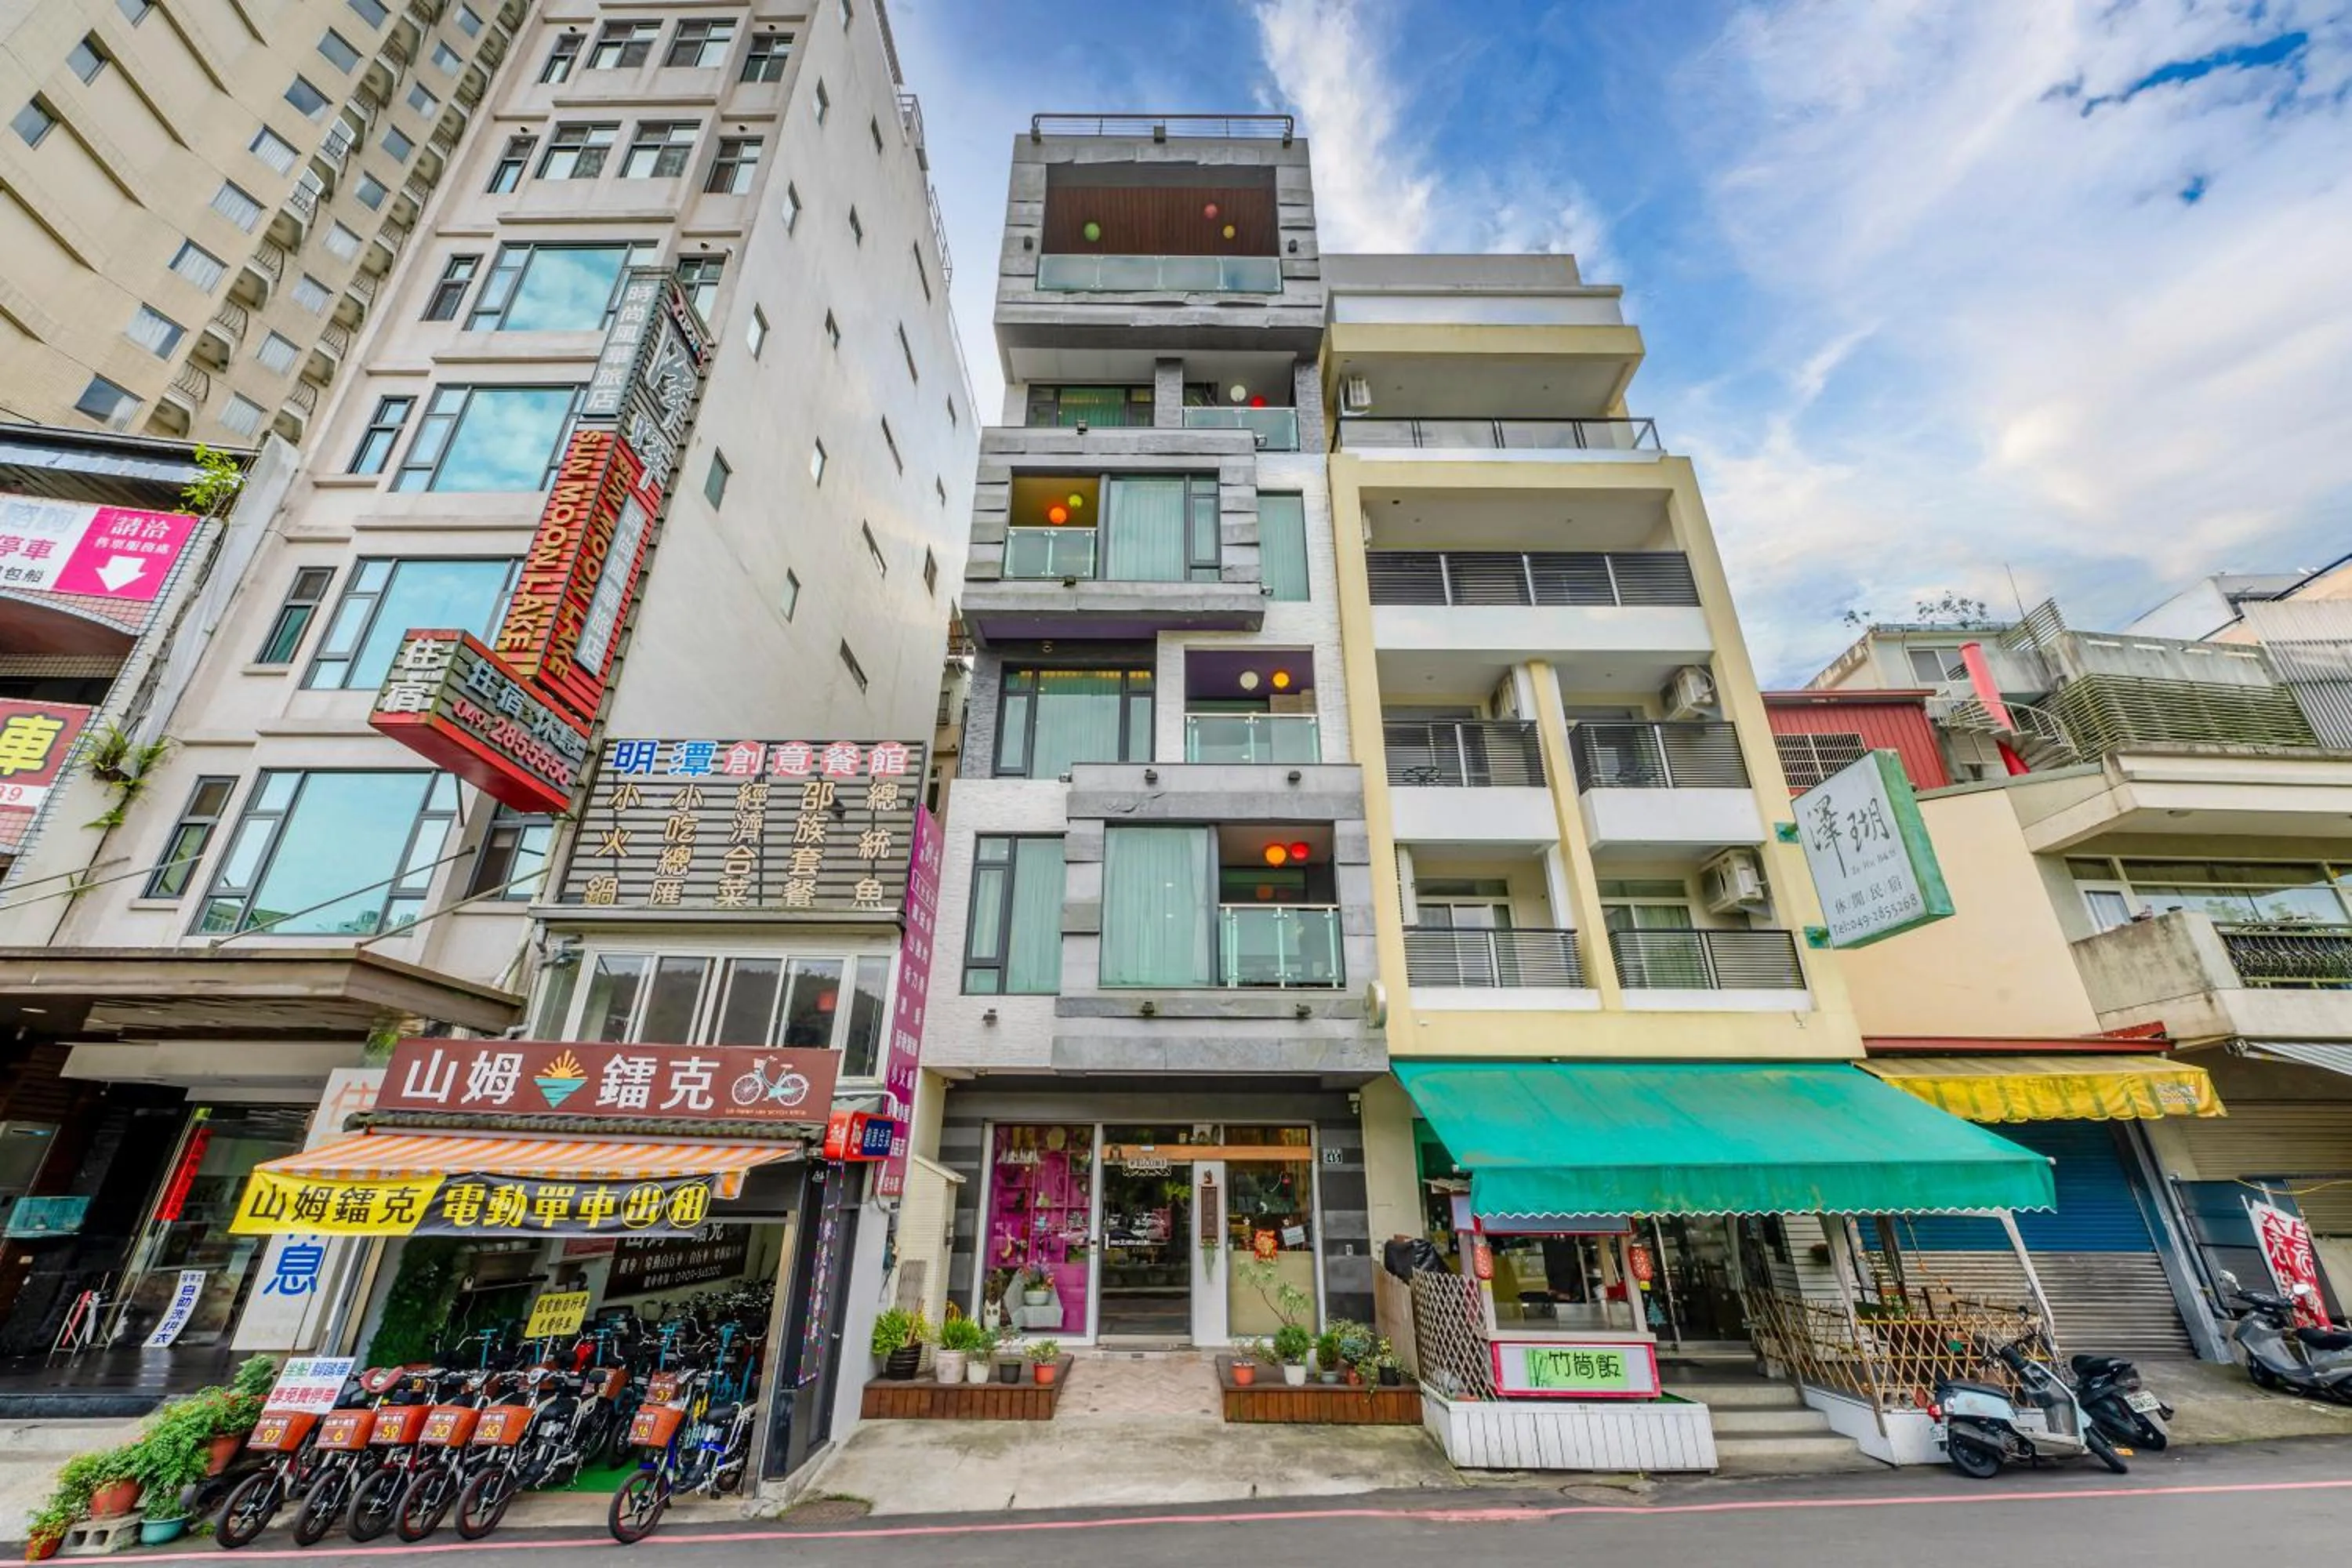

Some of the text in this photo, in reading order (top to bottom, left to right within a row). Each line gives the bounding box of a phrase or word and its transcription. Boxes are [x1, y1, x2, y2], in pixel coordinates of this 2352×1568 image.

[508, 430, 603, 652] SUN MOON LAKE
[549, 600, 585, 681] LAKE
[614, 741, 909, 777] 明潭創意餐館
[583, 782, 642, 905] 小火鍋
[649, 782, 705, 906] 小吃總匯
[714, 781, 771, 907] 經濟合菜
[782, 781, 835, 907] 邵族套餐
[851, 782, 899, 907] 總統魚
[401, 1048, 720, 1110] 山姆 鐳克
[248, 1182, 709, 1229] 山姆鐳克 電動單車出租
[263, 1242, 324, 1296] 息
[1548, 1350, 1621, 1380] 竹筒飯
[333, 1429, 344, 1442] 6
